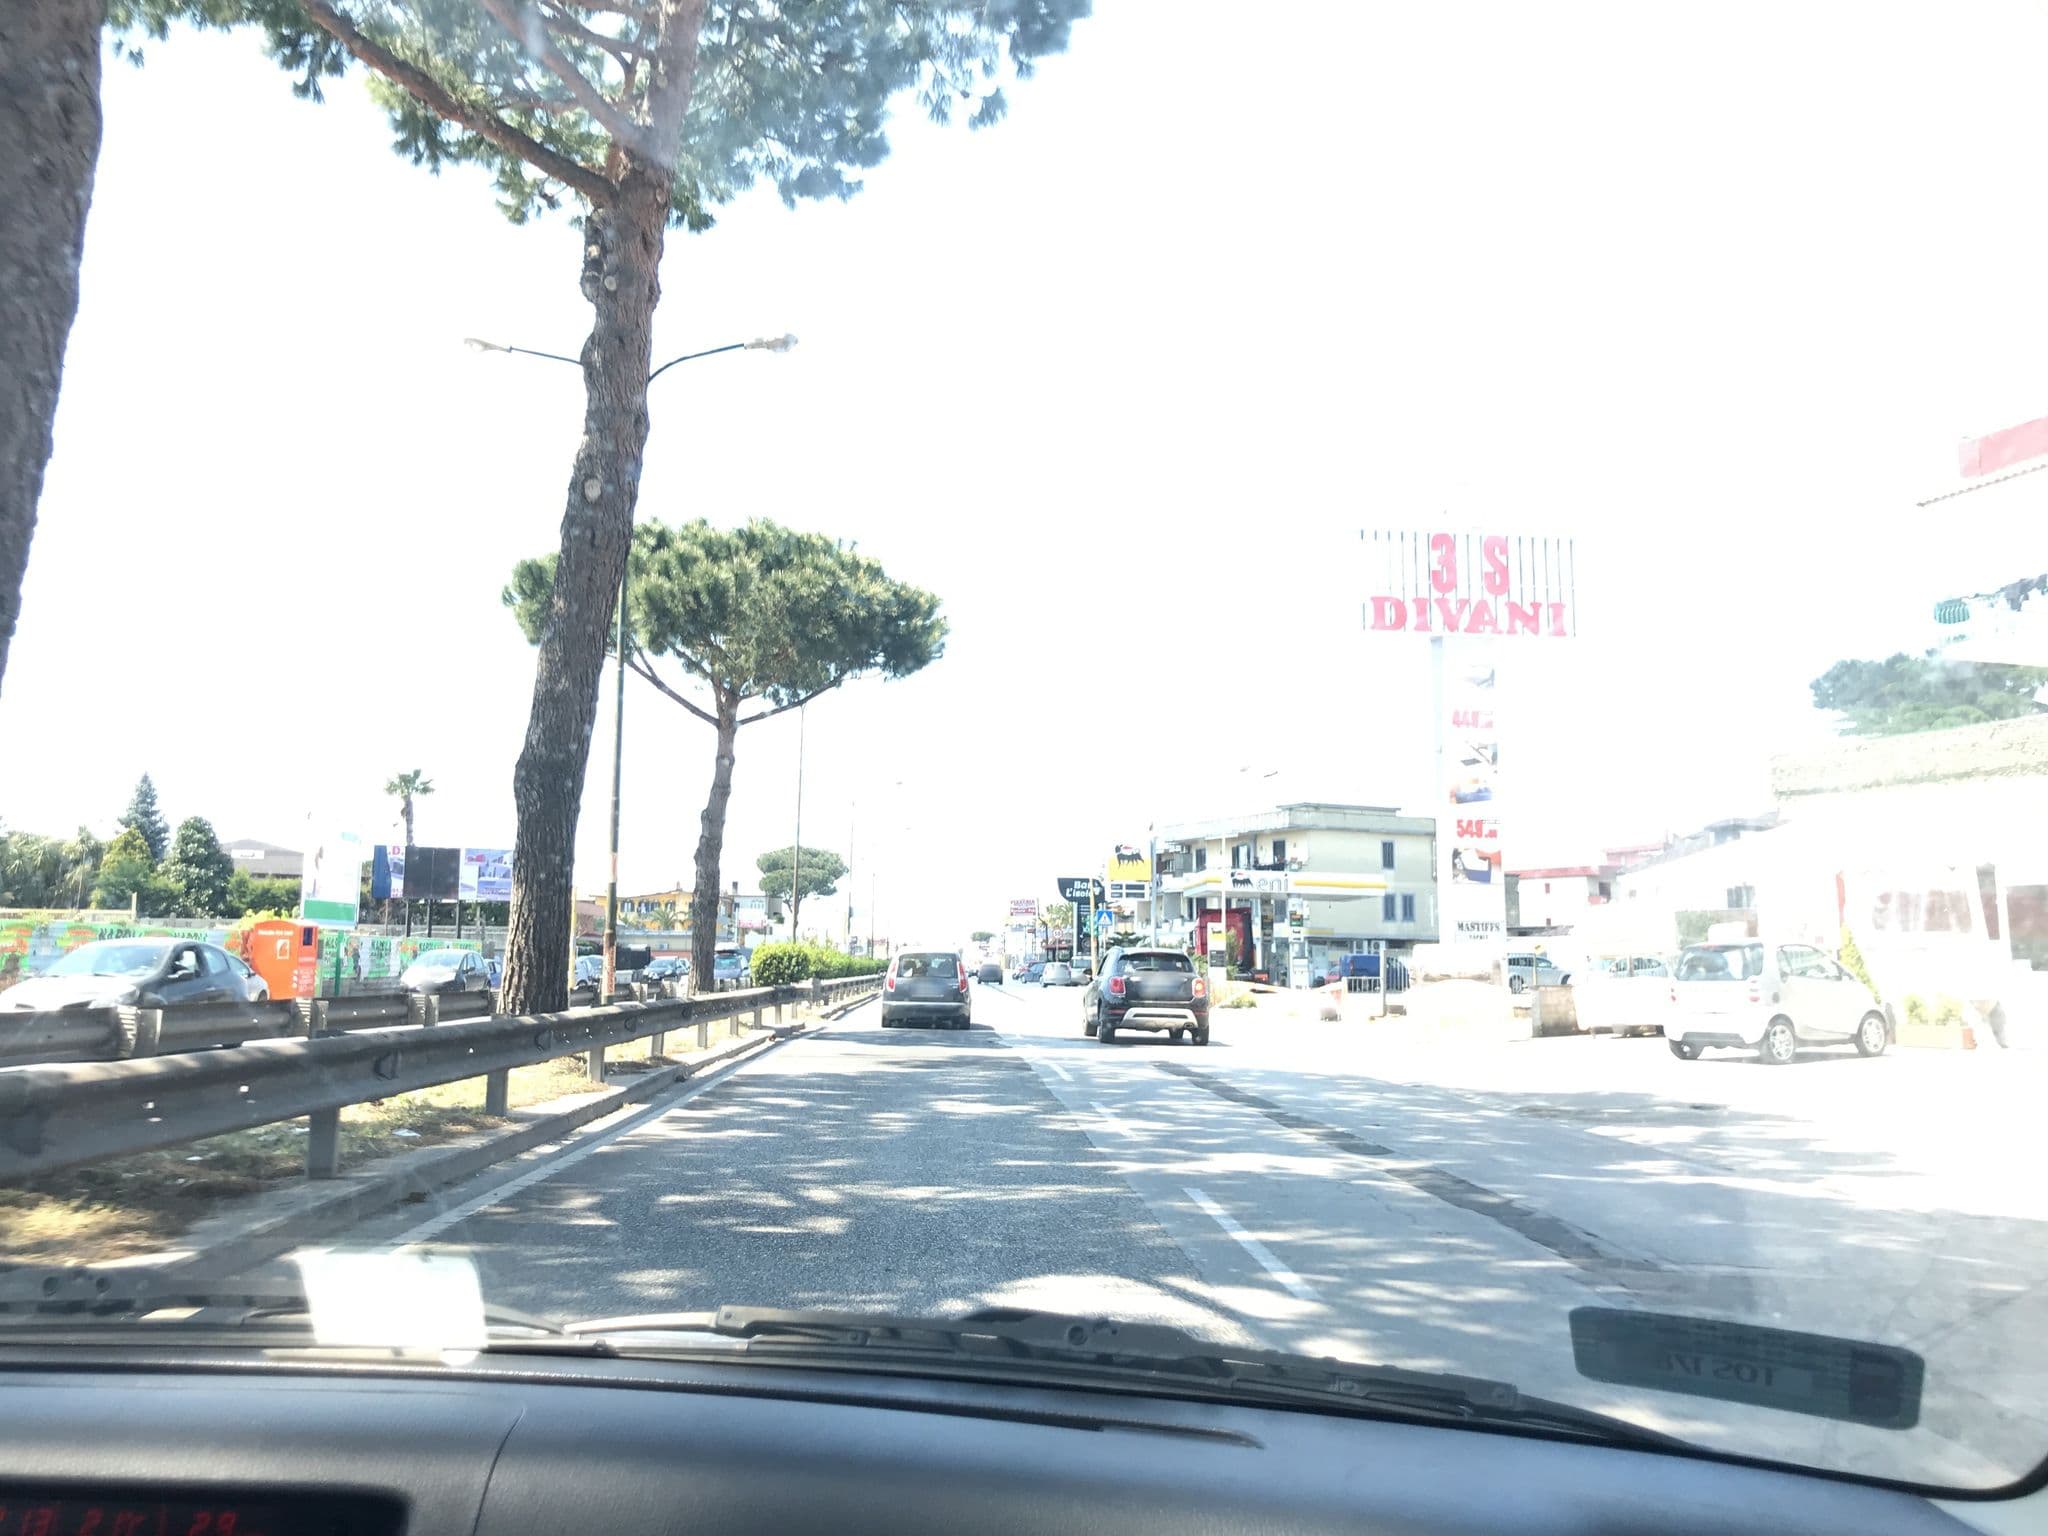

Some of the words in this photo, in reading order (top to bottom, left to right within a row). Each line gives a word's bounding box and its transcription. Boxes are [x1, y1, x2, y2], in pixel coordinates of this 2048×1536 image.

[1431, 533, 1457, 596] 3
[1483, 536, 1511, 597] S
[1370, 595, 1568, 638] DIVANI
[1257, 873, 1289, 892] eni
